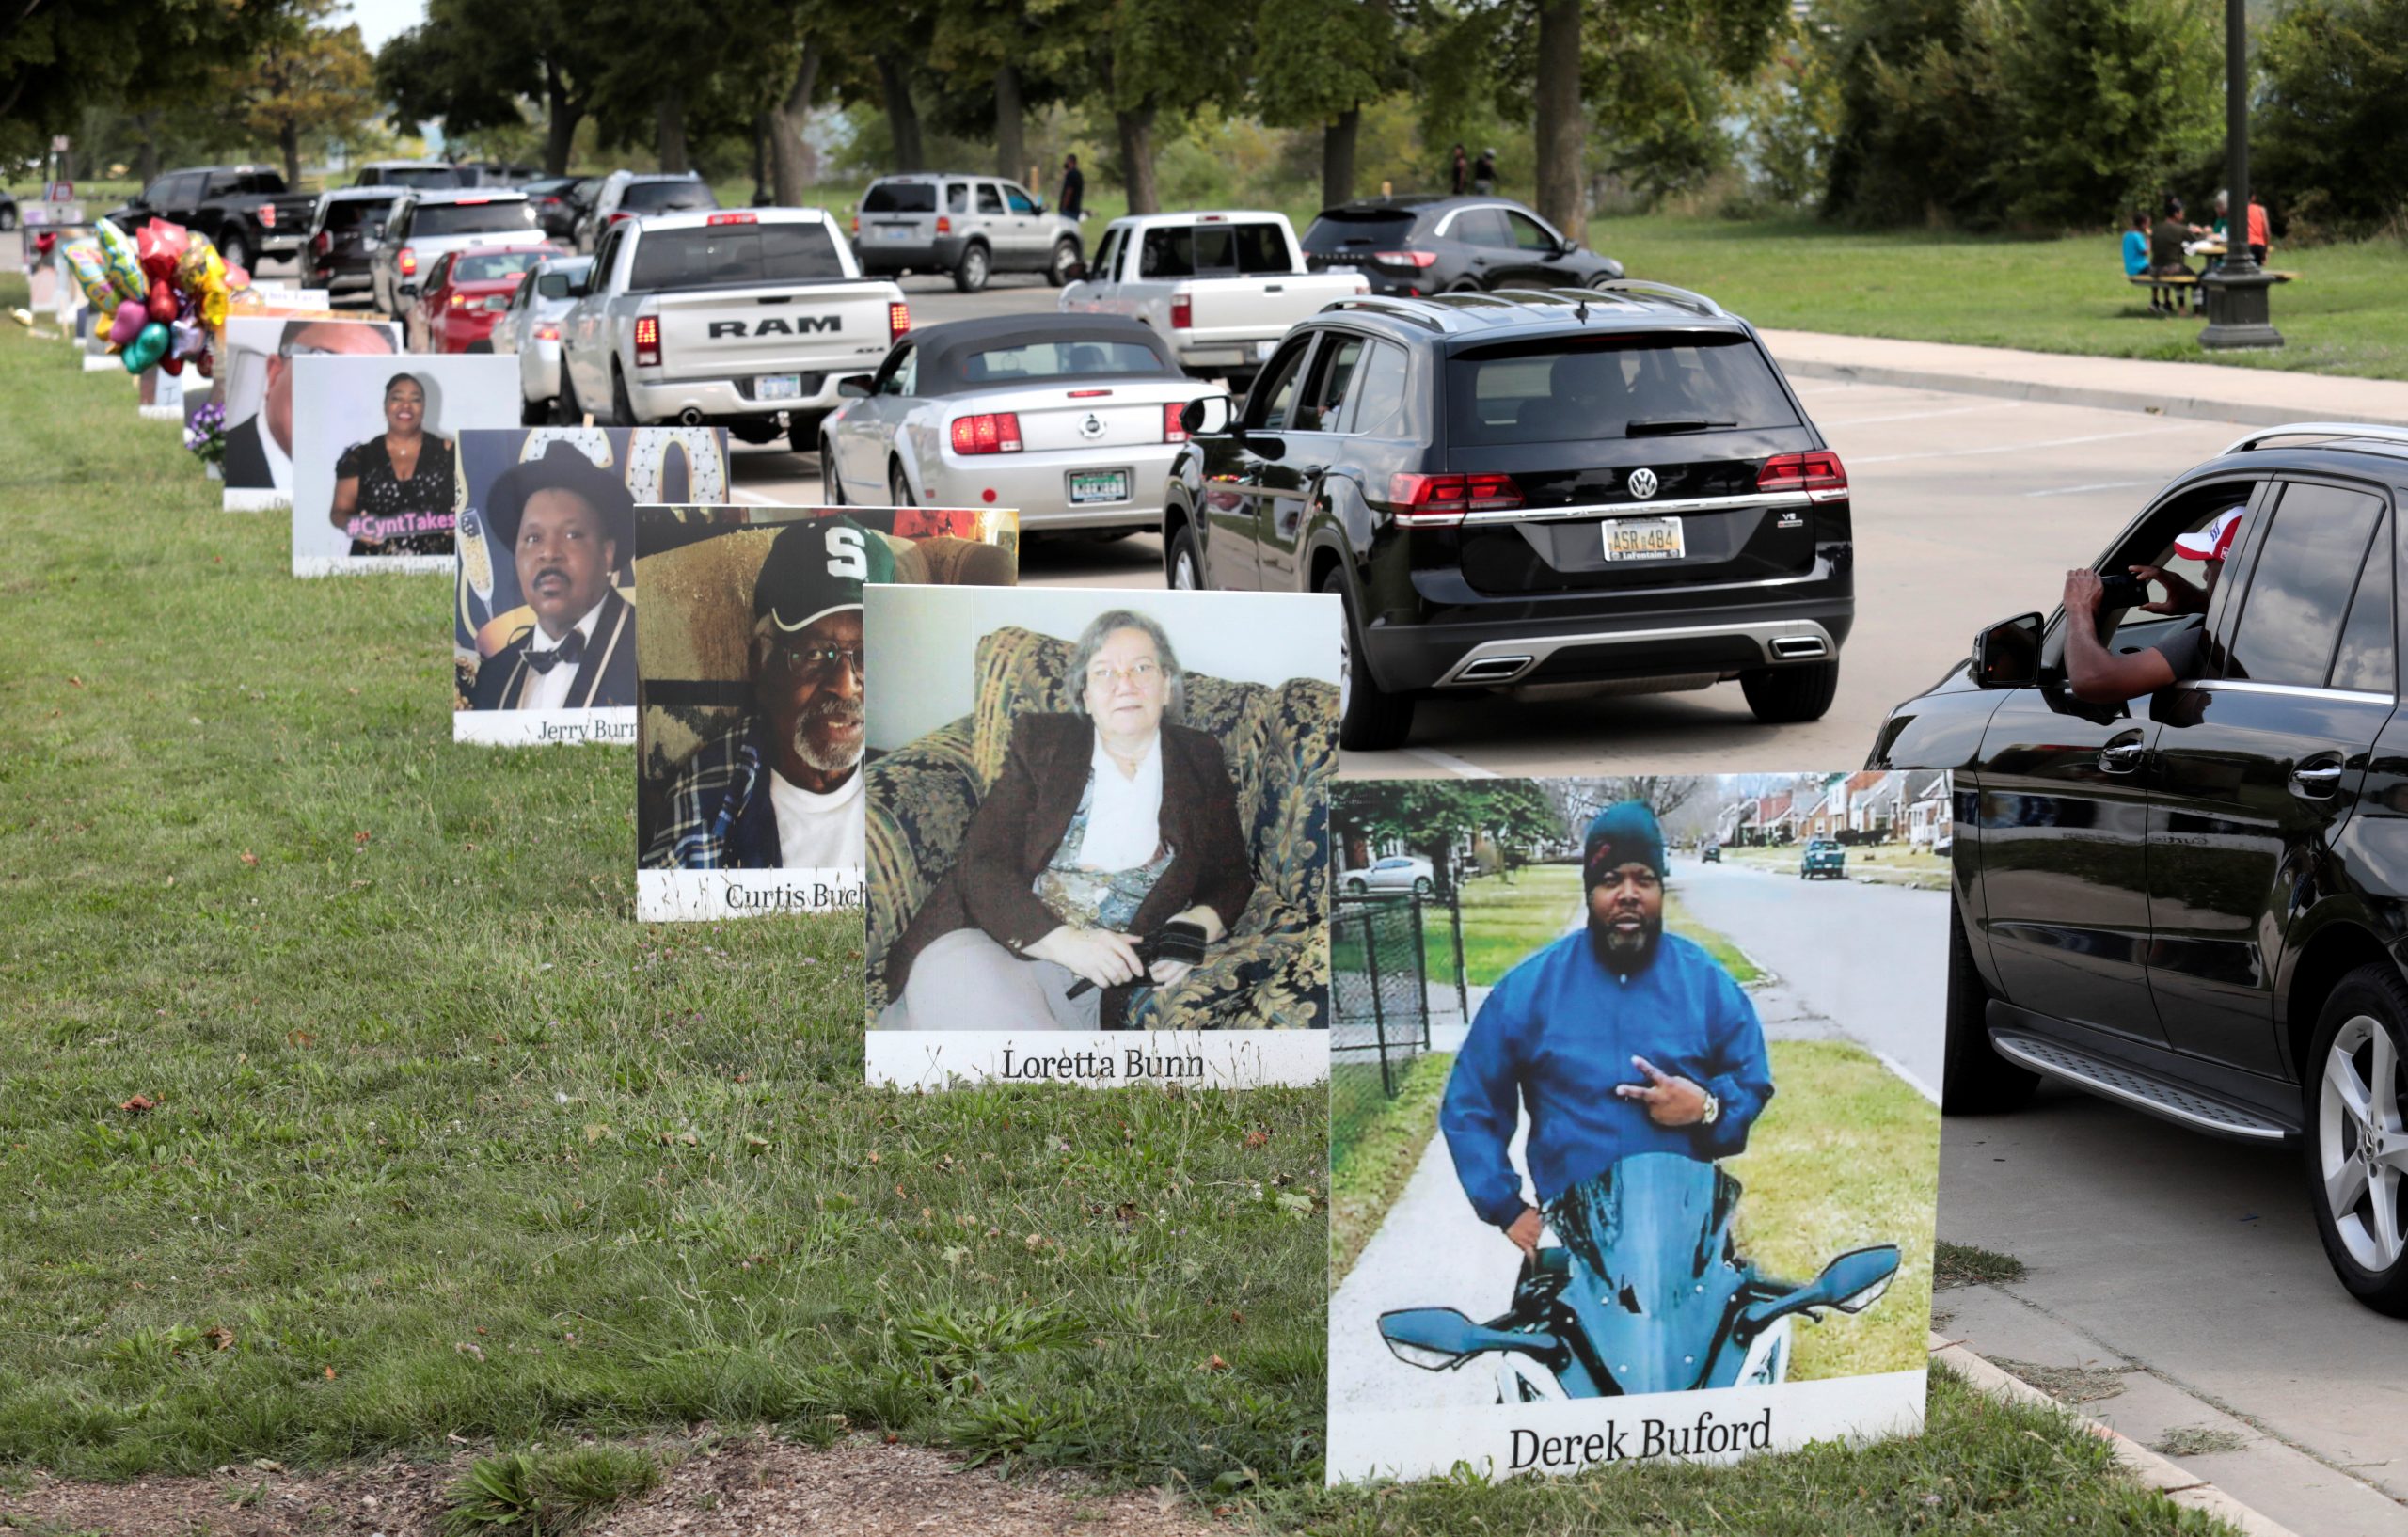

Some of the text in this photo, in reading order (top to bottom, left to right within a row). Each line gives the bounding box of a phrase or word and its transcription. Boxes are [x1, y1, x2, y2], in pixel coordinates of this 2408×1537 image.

[708, 315, 843, 340] RAM
[347, 511, 455, 538] #CyntTakes
[1614, 531, 1639, 550] ASR
[1648, 529, 1673, 548] 484
[825, 526, 868, 581] S
[538, 721, 589, 744] Jerry
[726, 883, 805, 909] Curtis
[1003, 1049, 1204, 1079] Loretta Bunn
[1509, 1407, 1772, 1469] Derek Buford
